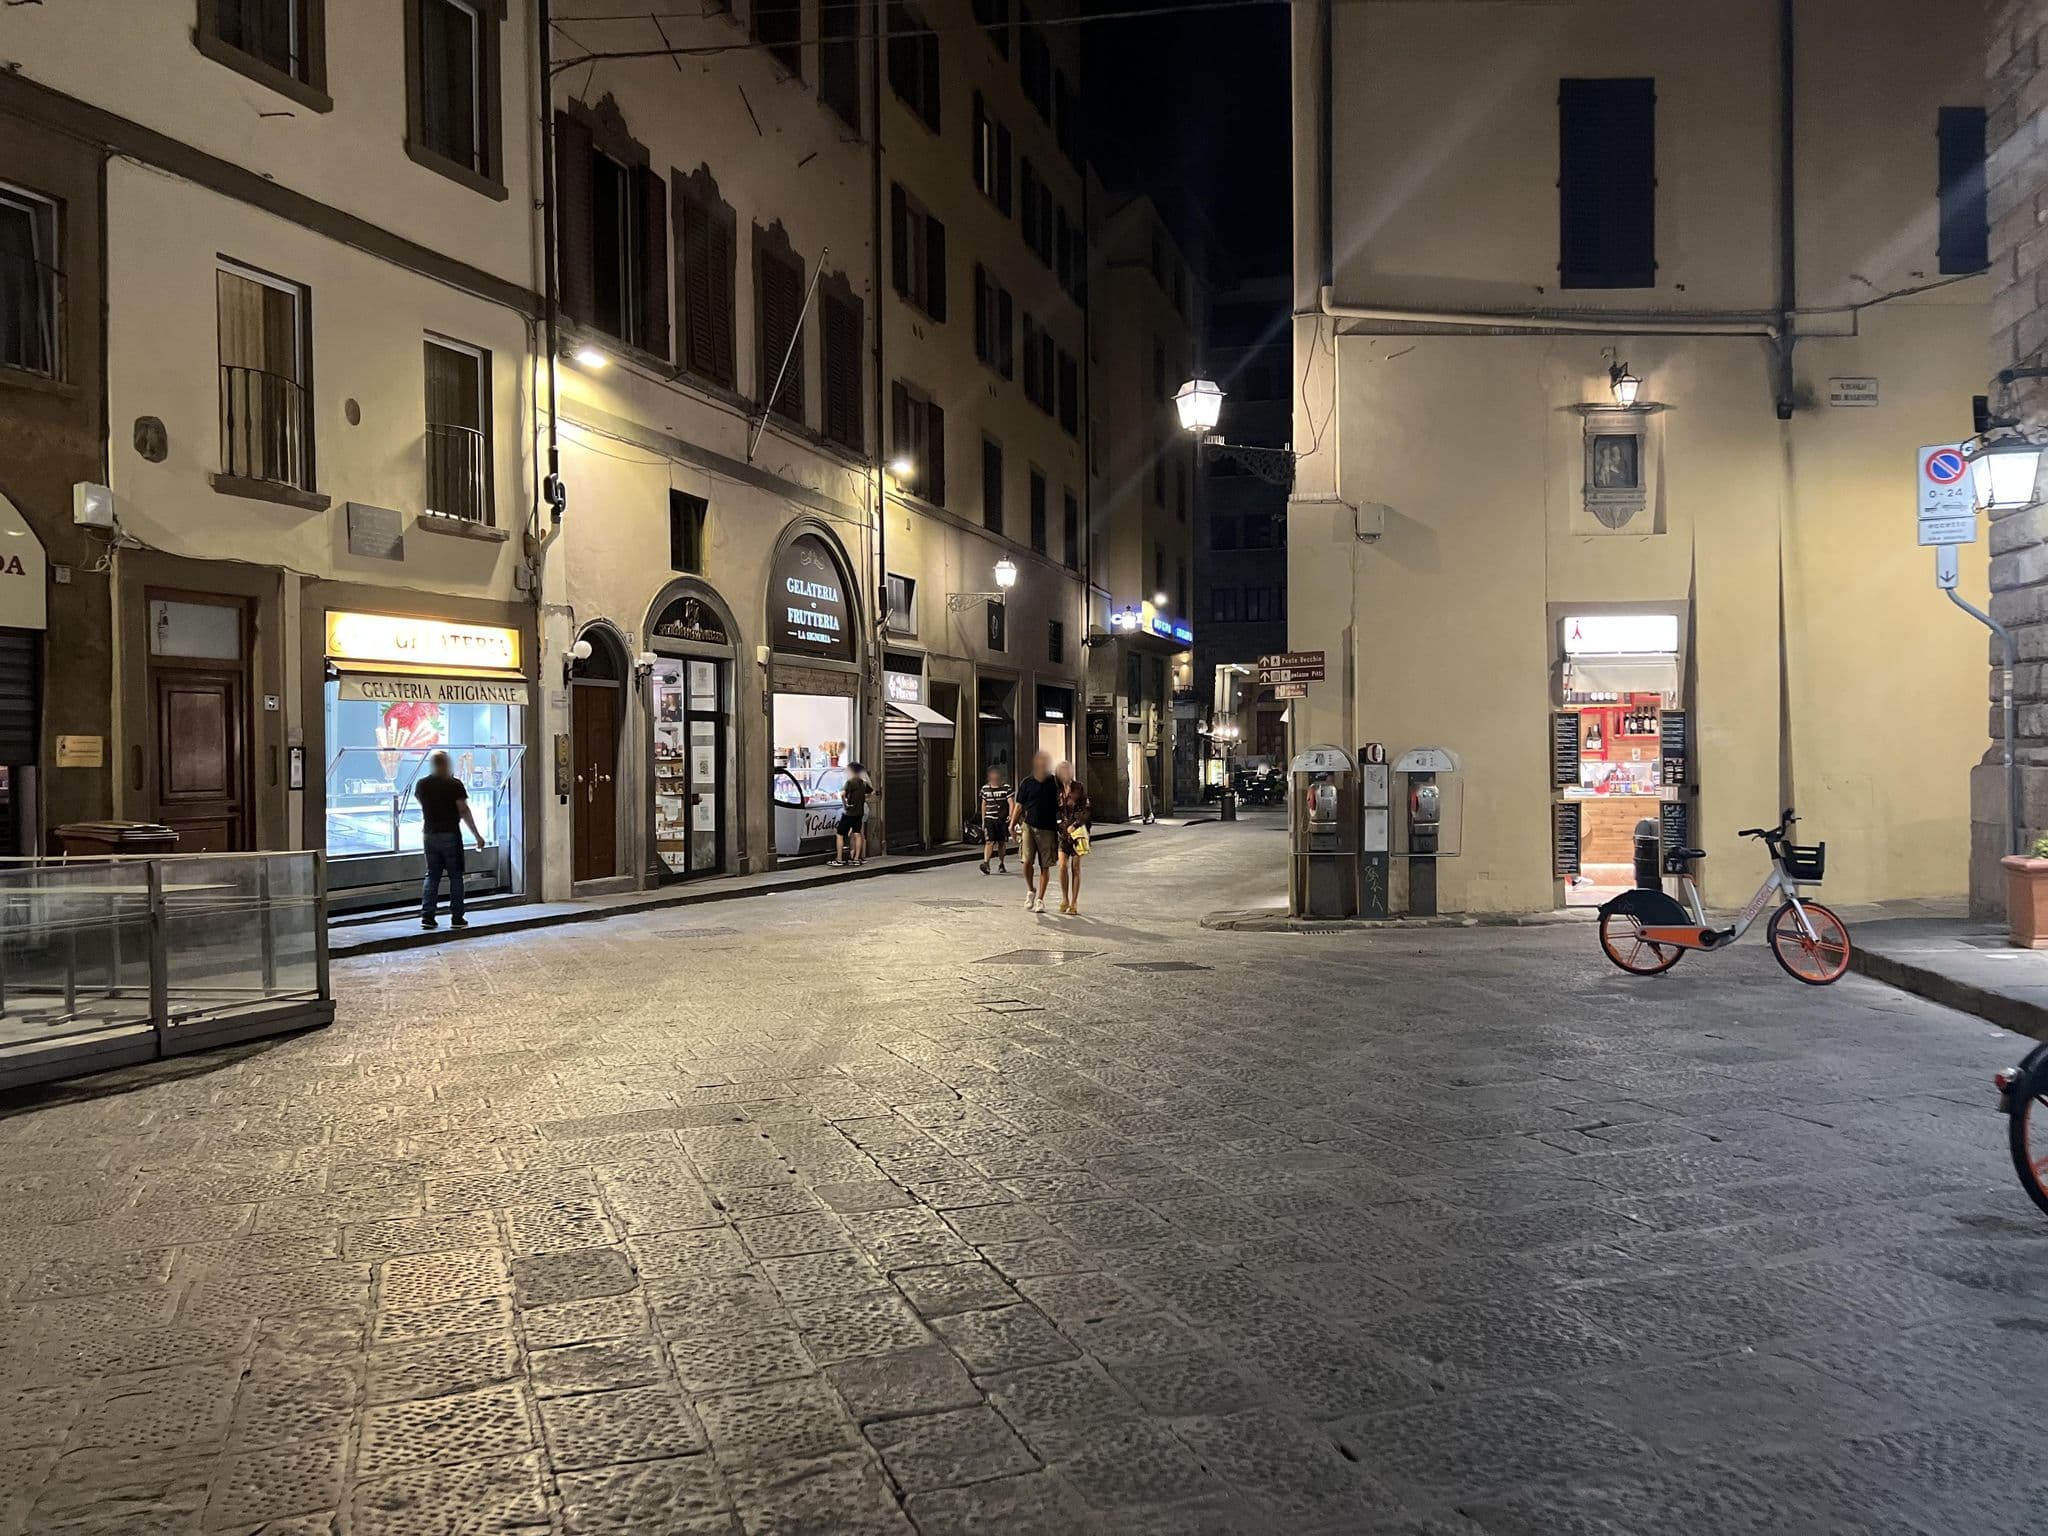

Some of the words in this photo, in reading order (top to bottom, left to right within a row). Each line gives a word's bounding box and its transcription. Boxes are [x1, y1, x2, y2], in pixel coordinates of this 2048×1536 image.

[1947, 488, 1963, 497] 24
[786, 577, 838, 602] GELATERIA
[787, 607, 840, 630] FRUTTERIA
[395, 630, 508, 656] GATERIA
[798, 630, 806, 640] LA
[361, 681, 431, 700] GELATERIA
[438, 683, 517, 702] ARTIGIANALE
[811, 814, 841, 836] Gelato
